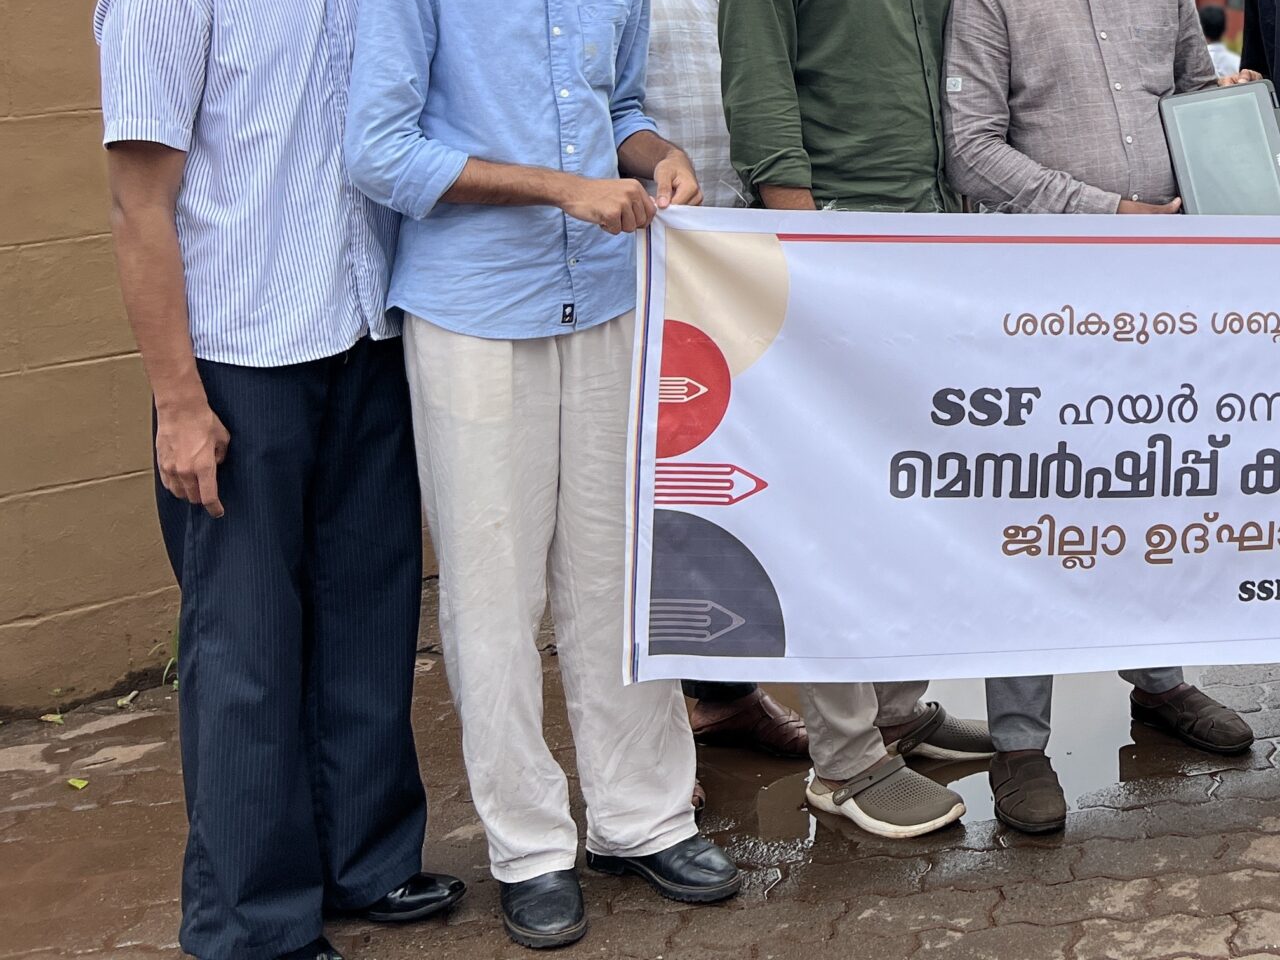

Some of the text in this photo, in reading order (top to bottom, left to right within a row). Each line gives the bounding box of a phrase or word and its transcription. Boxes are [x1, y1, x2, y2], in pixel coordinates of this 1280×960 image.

[1003, 304, 1198, 344] ശരികളുടെ
[930, 386, 1042, 426] SSF
[1058, 382, 1199, 425] ഹയർ
[889, 432, 1231, 499] മെമ്പർഷിപ്പ്
[1001, 513, 1127, 570] ജില്ലാ
